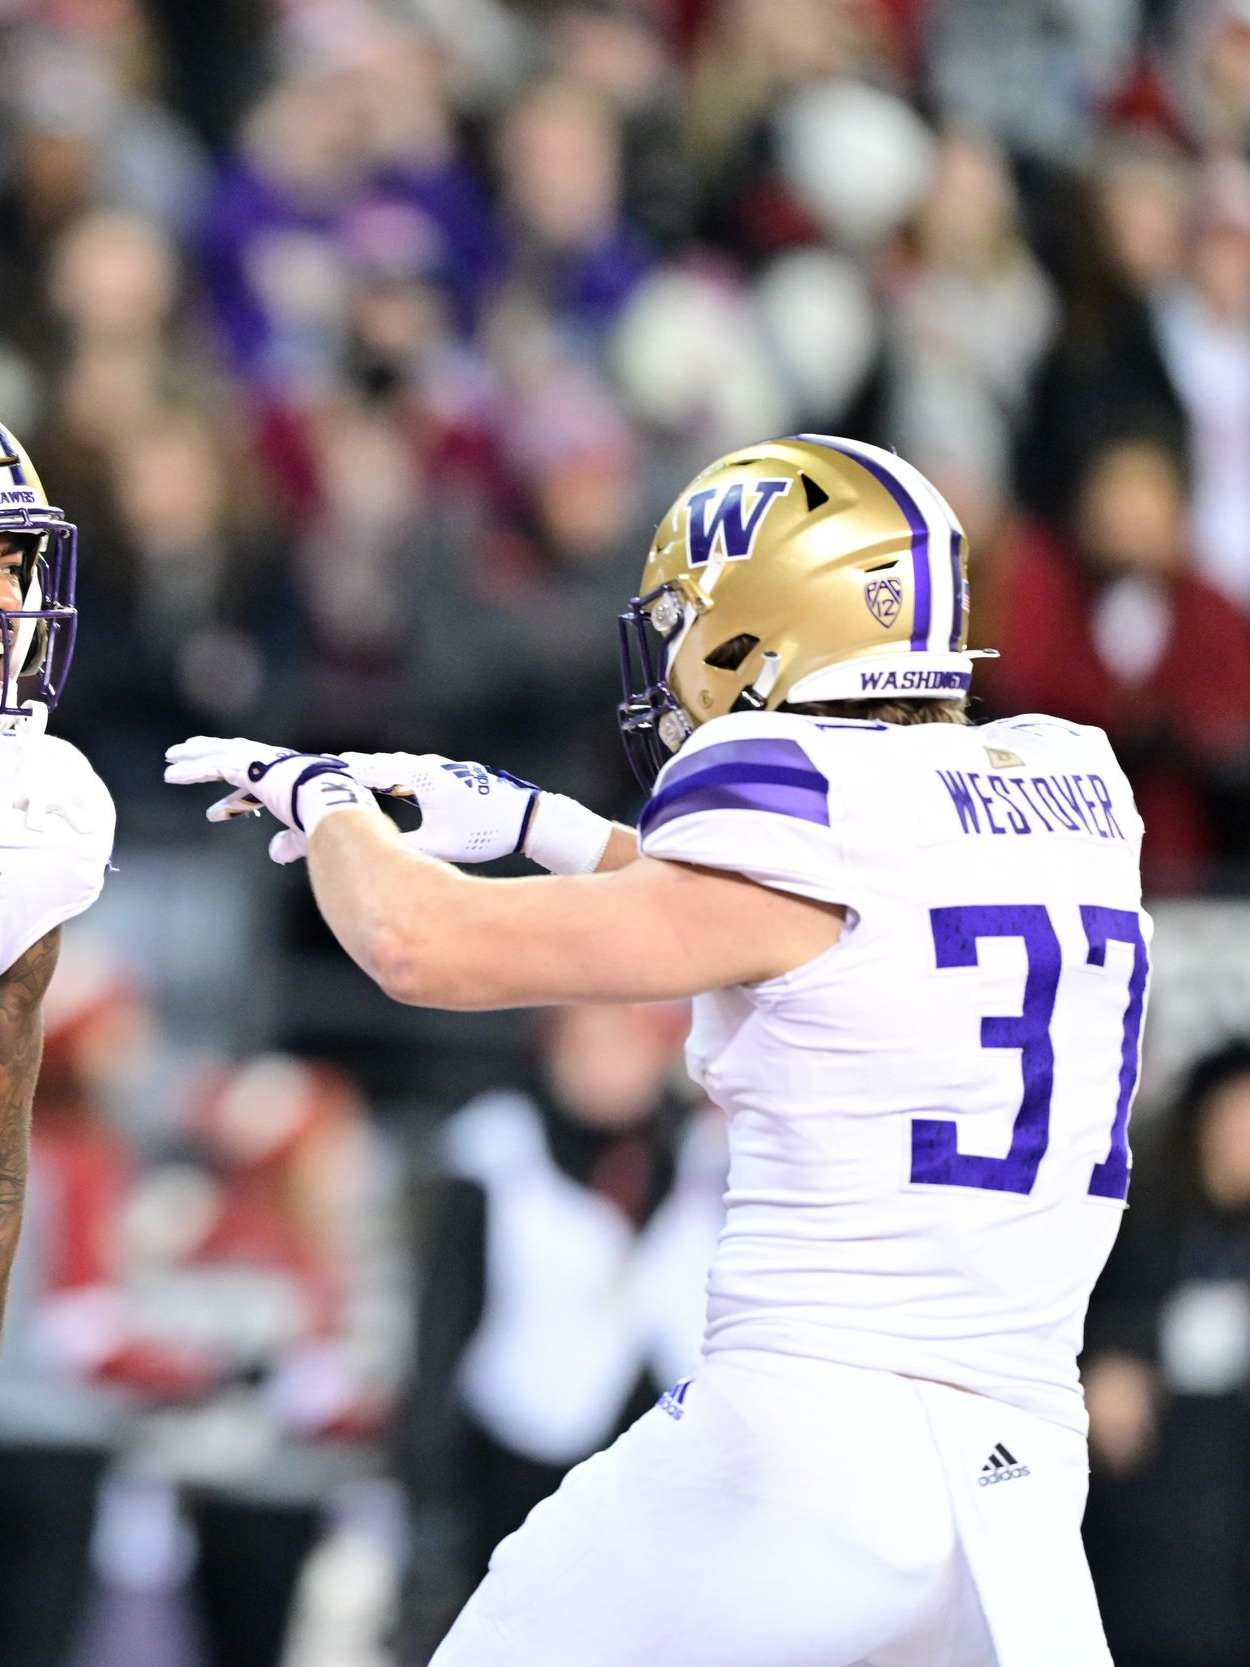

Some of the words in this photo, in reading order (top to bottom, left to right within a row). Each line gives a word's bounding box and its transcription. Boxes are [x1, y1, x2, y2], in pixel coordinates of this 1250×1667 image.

[686, 477, 793, 569] W
[865, 578, 902, 608] PAC
[876, 598, 896, 617] 12
[935, 769, 1127, 841] WESTOVER
[910, 903, 1150, 1200] 37
[978, 1465, 1031, 1487] adidas
